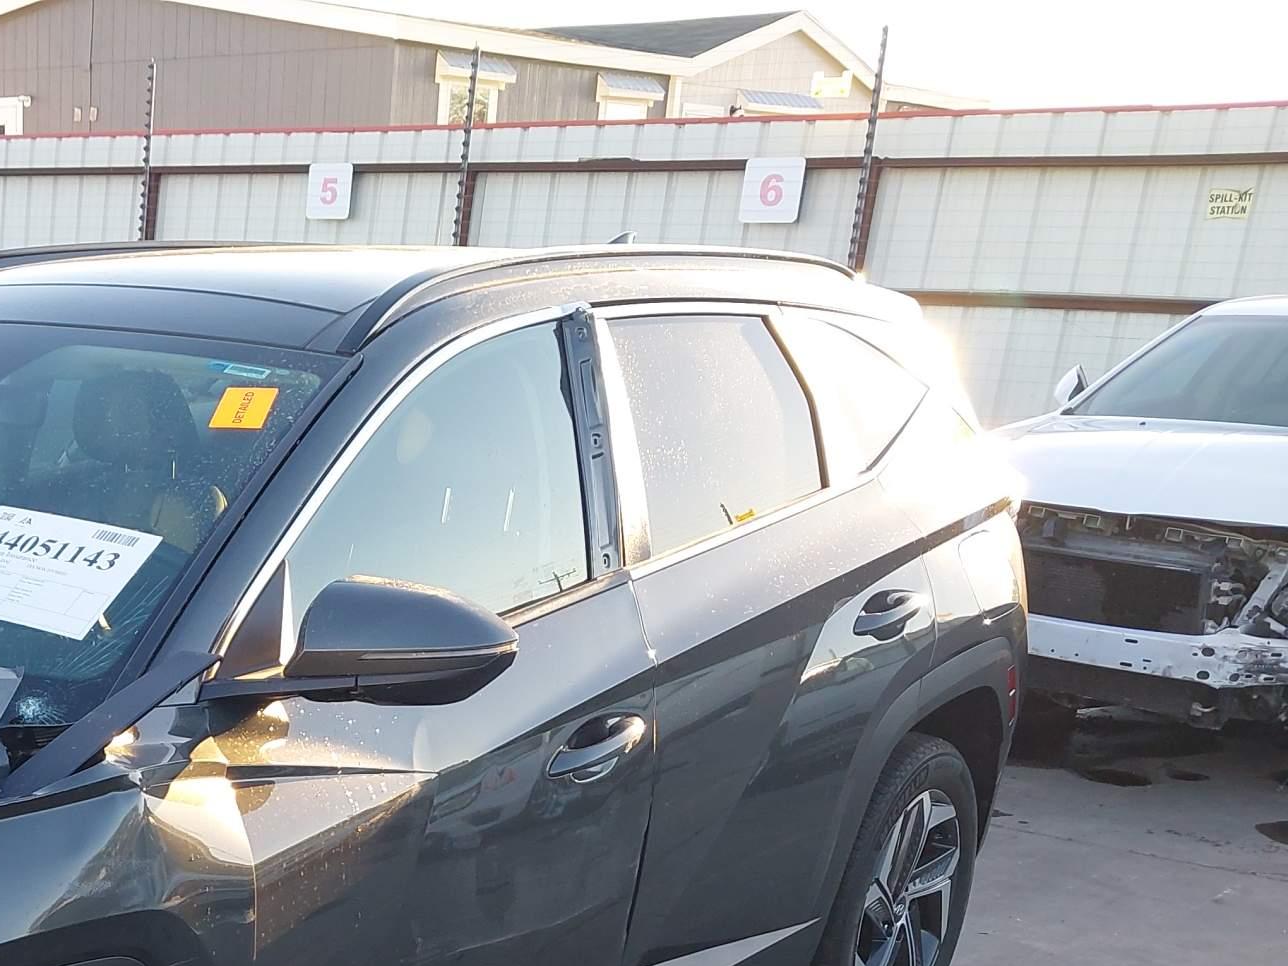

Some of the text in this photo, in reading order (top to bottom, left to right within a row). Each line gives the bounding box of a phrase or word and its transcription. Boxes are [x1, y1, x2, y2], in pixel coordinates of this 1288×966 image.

[320, 178, 339, 205] 5
[758, 174, 786, 207] 6
[1208, 192, 1253, 203] SPILL-KIT
[1209, 205, 1248, 216] STATION
[232, 391, 255, 424] DETAILED
